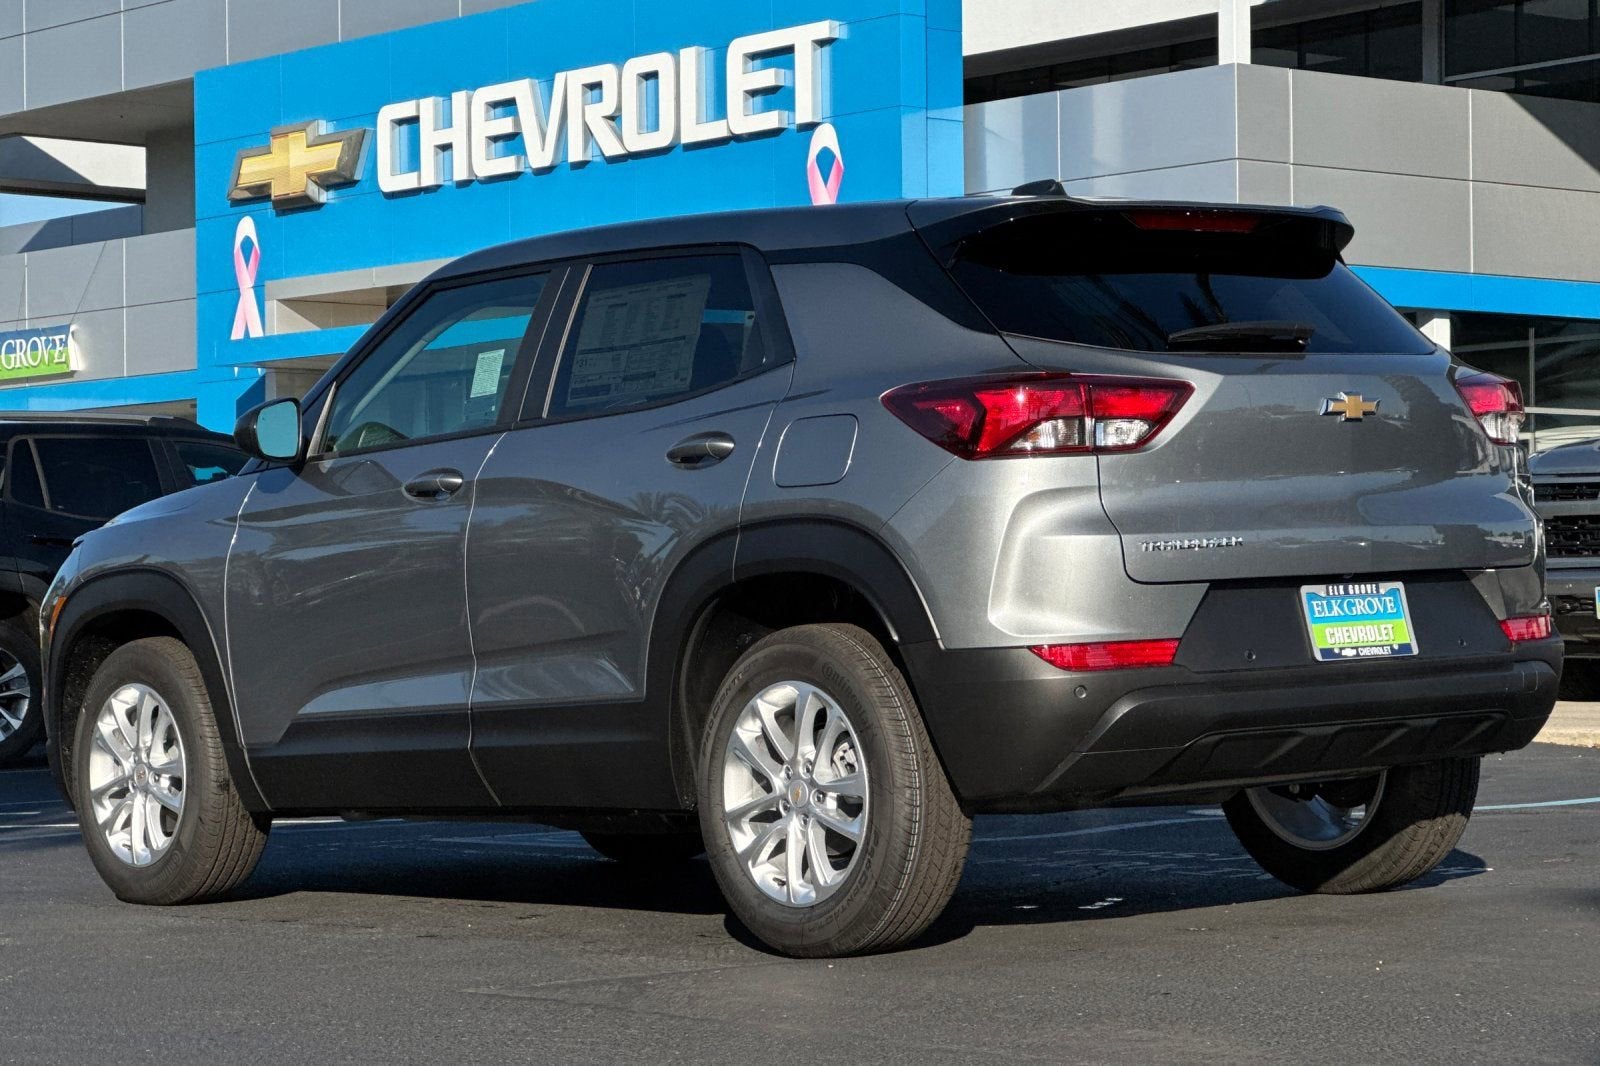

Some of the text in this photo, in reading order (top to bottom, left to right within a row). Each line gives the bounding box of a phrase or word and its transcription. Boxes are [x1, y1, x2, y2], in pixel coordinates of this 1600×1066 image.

[377, 20, 842, 194] CHEVROLET
[1, 334, 67, 370] GROVE
[1328, 584, 1377, 595] ELK GROVE
[1311, 597, 1397, 618] ELK GROVE
[1325, 624, 1394, 645] CHEVROLET
[1358, 646, 1393, 656] CHEVROLET
